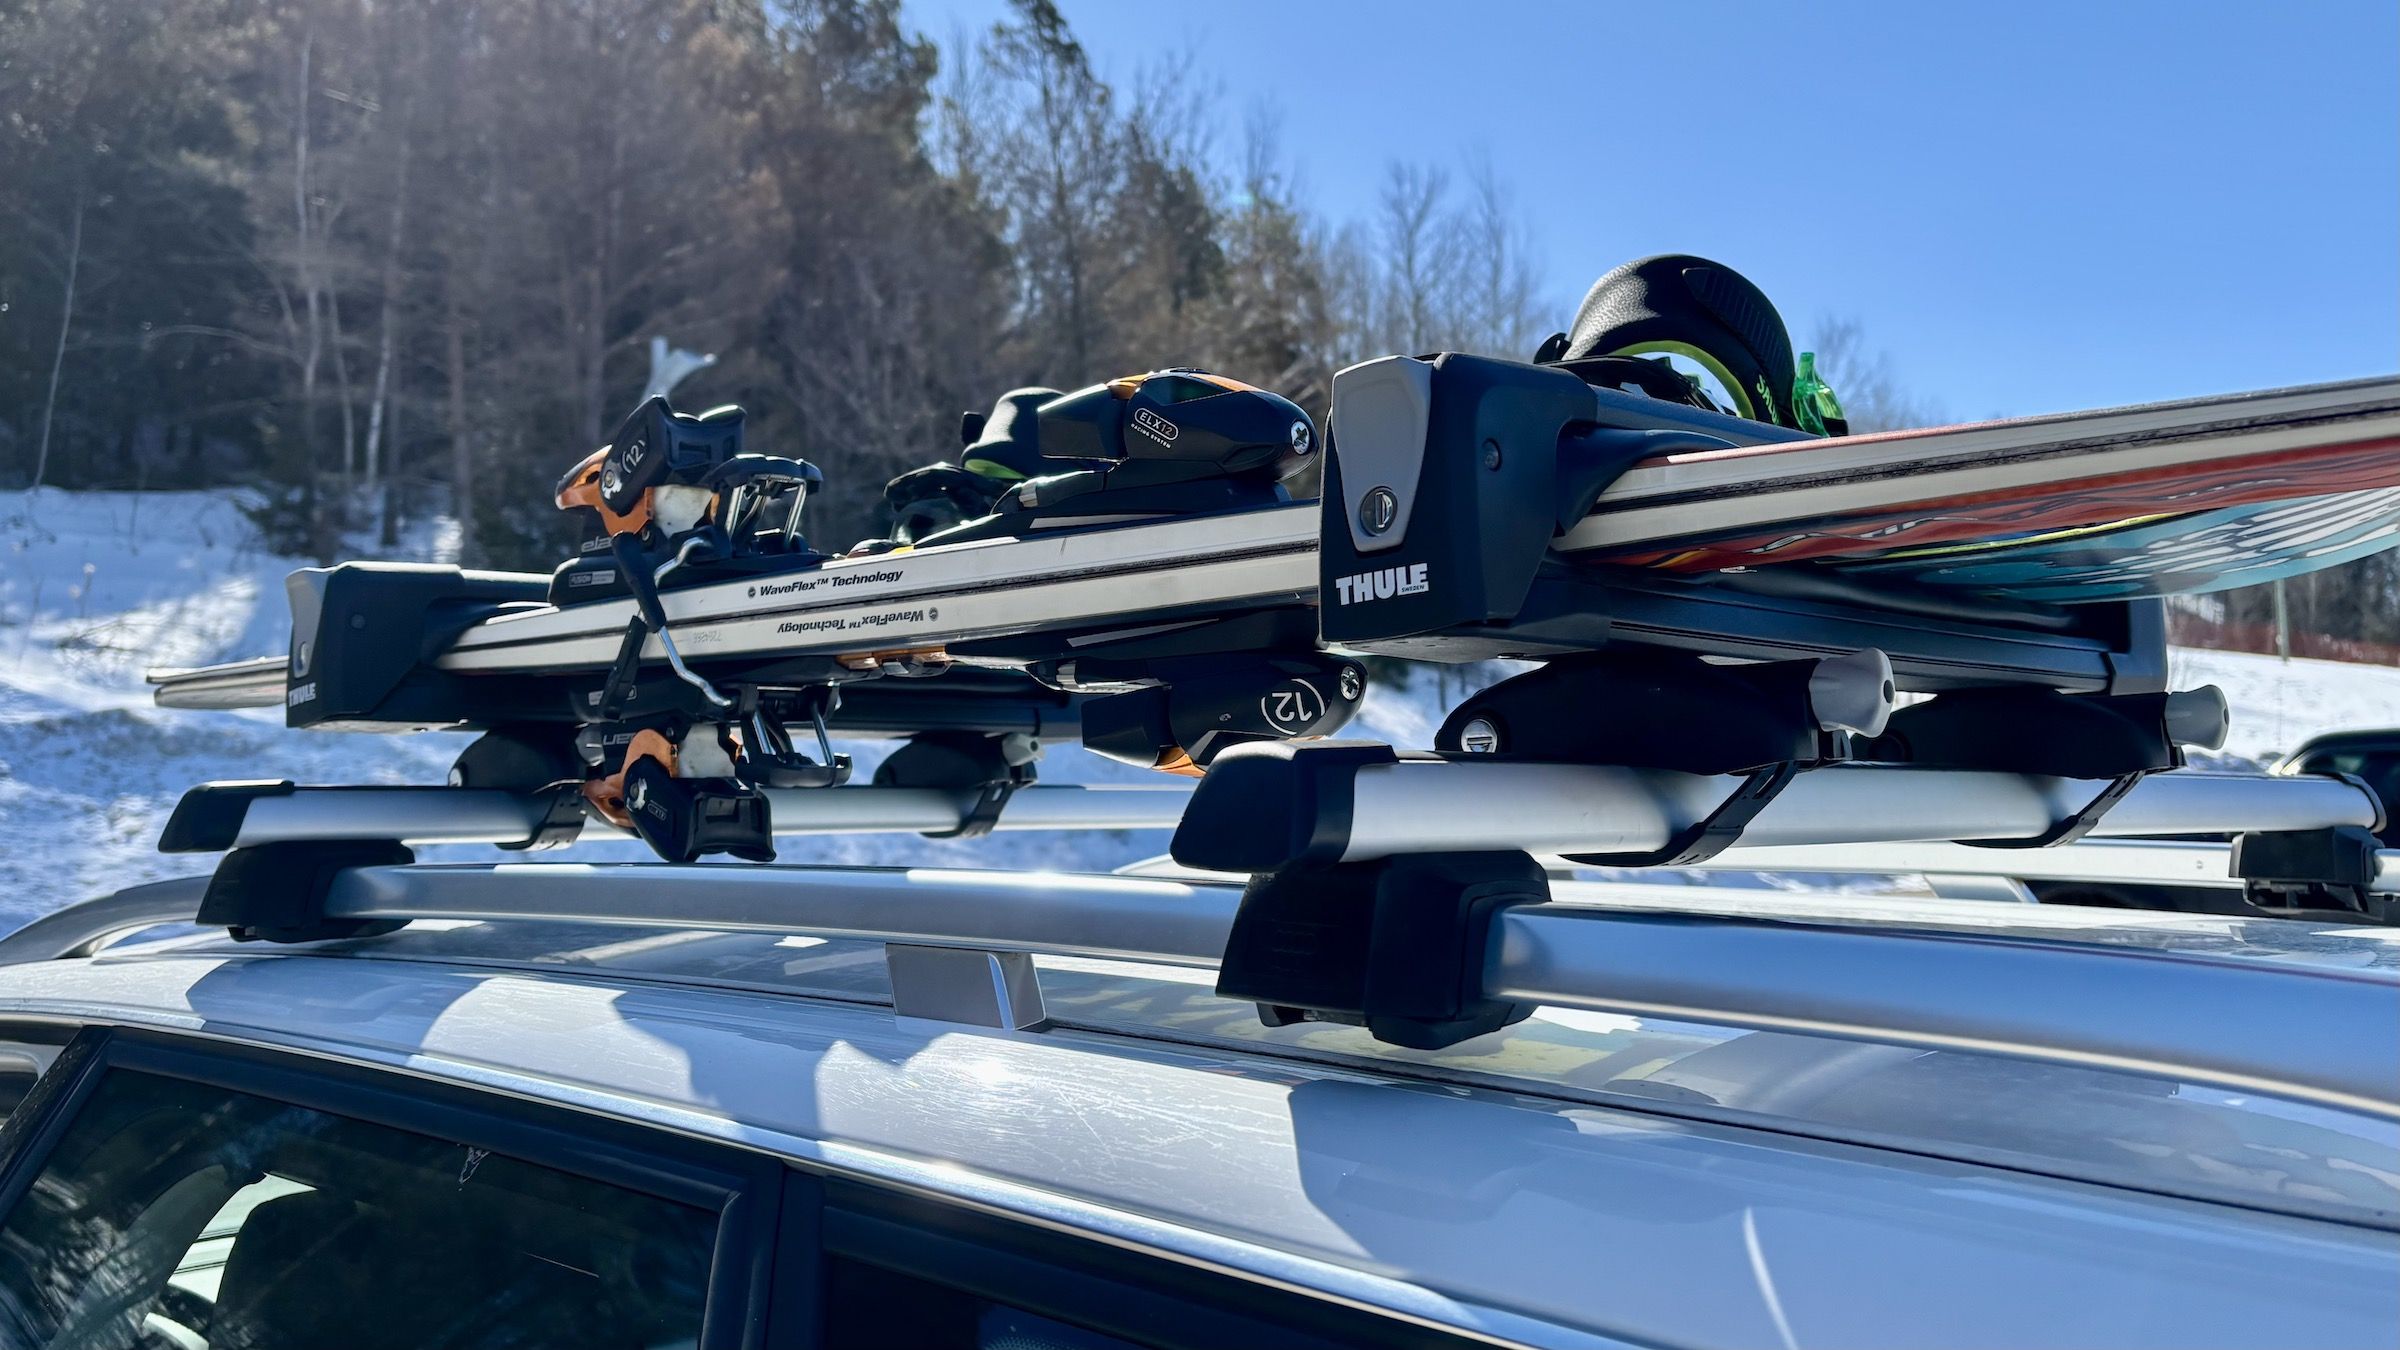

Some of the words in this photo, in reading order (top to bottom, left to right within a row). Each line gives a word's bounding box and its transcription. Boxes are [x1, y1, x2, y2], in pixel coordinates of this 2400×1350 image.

[1150, 433, 1171, 449] SYSTEM
[831, 570, 904, 588] Technology
[1335, 562, 1430, 606] THULE
[1401, 584, 1425, 593] SWEDEN
[777, 618, 846, 634] Technology
[288, 681, 317, 707] THULE
